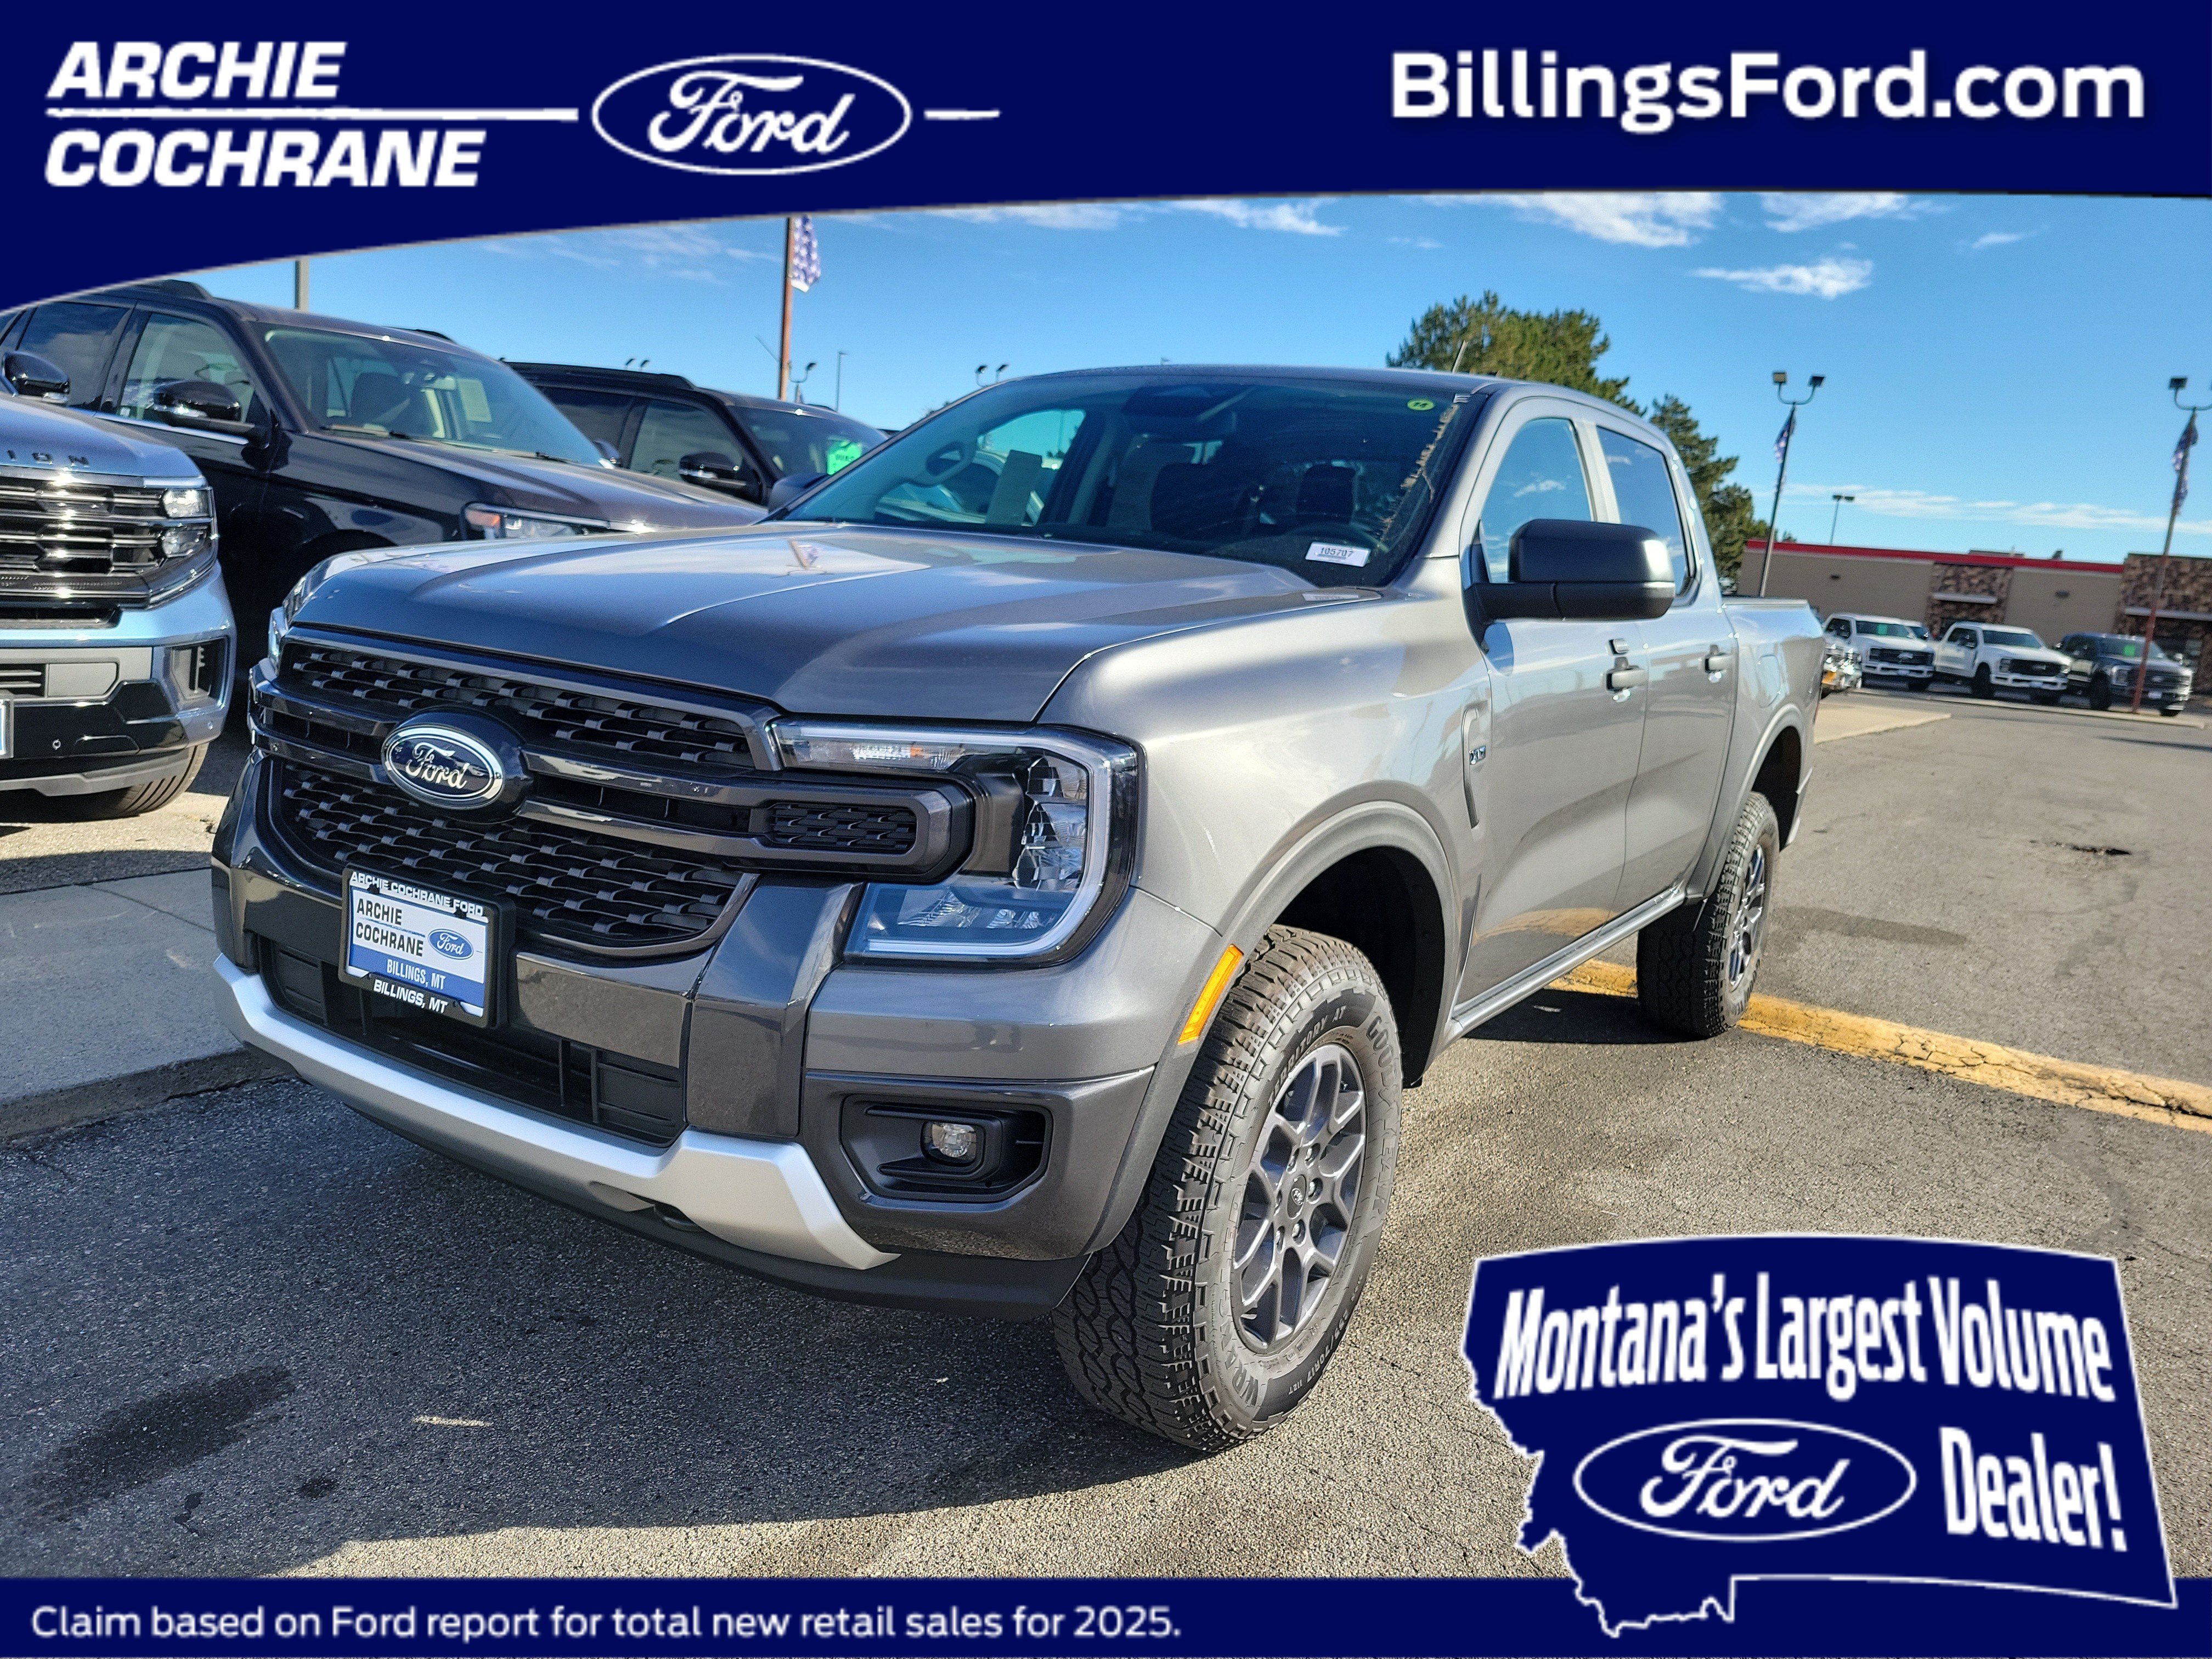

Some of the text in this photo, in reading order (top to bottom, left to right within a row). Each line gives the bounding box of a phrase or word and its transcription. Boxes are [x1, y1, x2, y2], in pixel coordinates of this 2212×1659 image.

[405, 742, 467, 789] Ford
[351, 872, 483, 916] ARCHIE COCHRANE FORD
[357, 898, 402, 926] ARCHIE
[356, 922, 424, 957] COCHRANE
[437, 933, 464, 956] Ford
[387, 959, 446, 990] BILLINGS, MT
[374, 979, 449, 1014] BILLINGS, MT
[1268, 1015, 1328, 1107] TERRITORY
